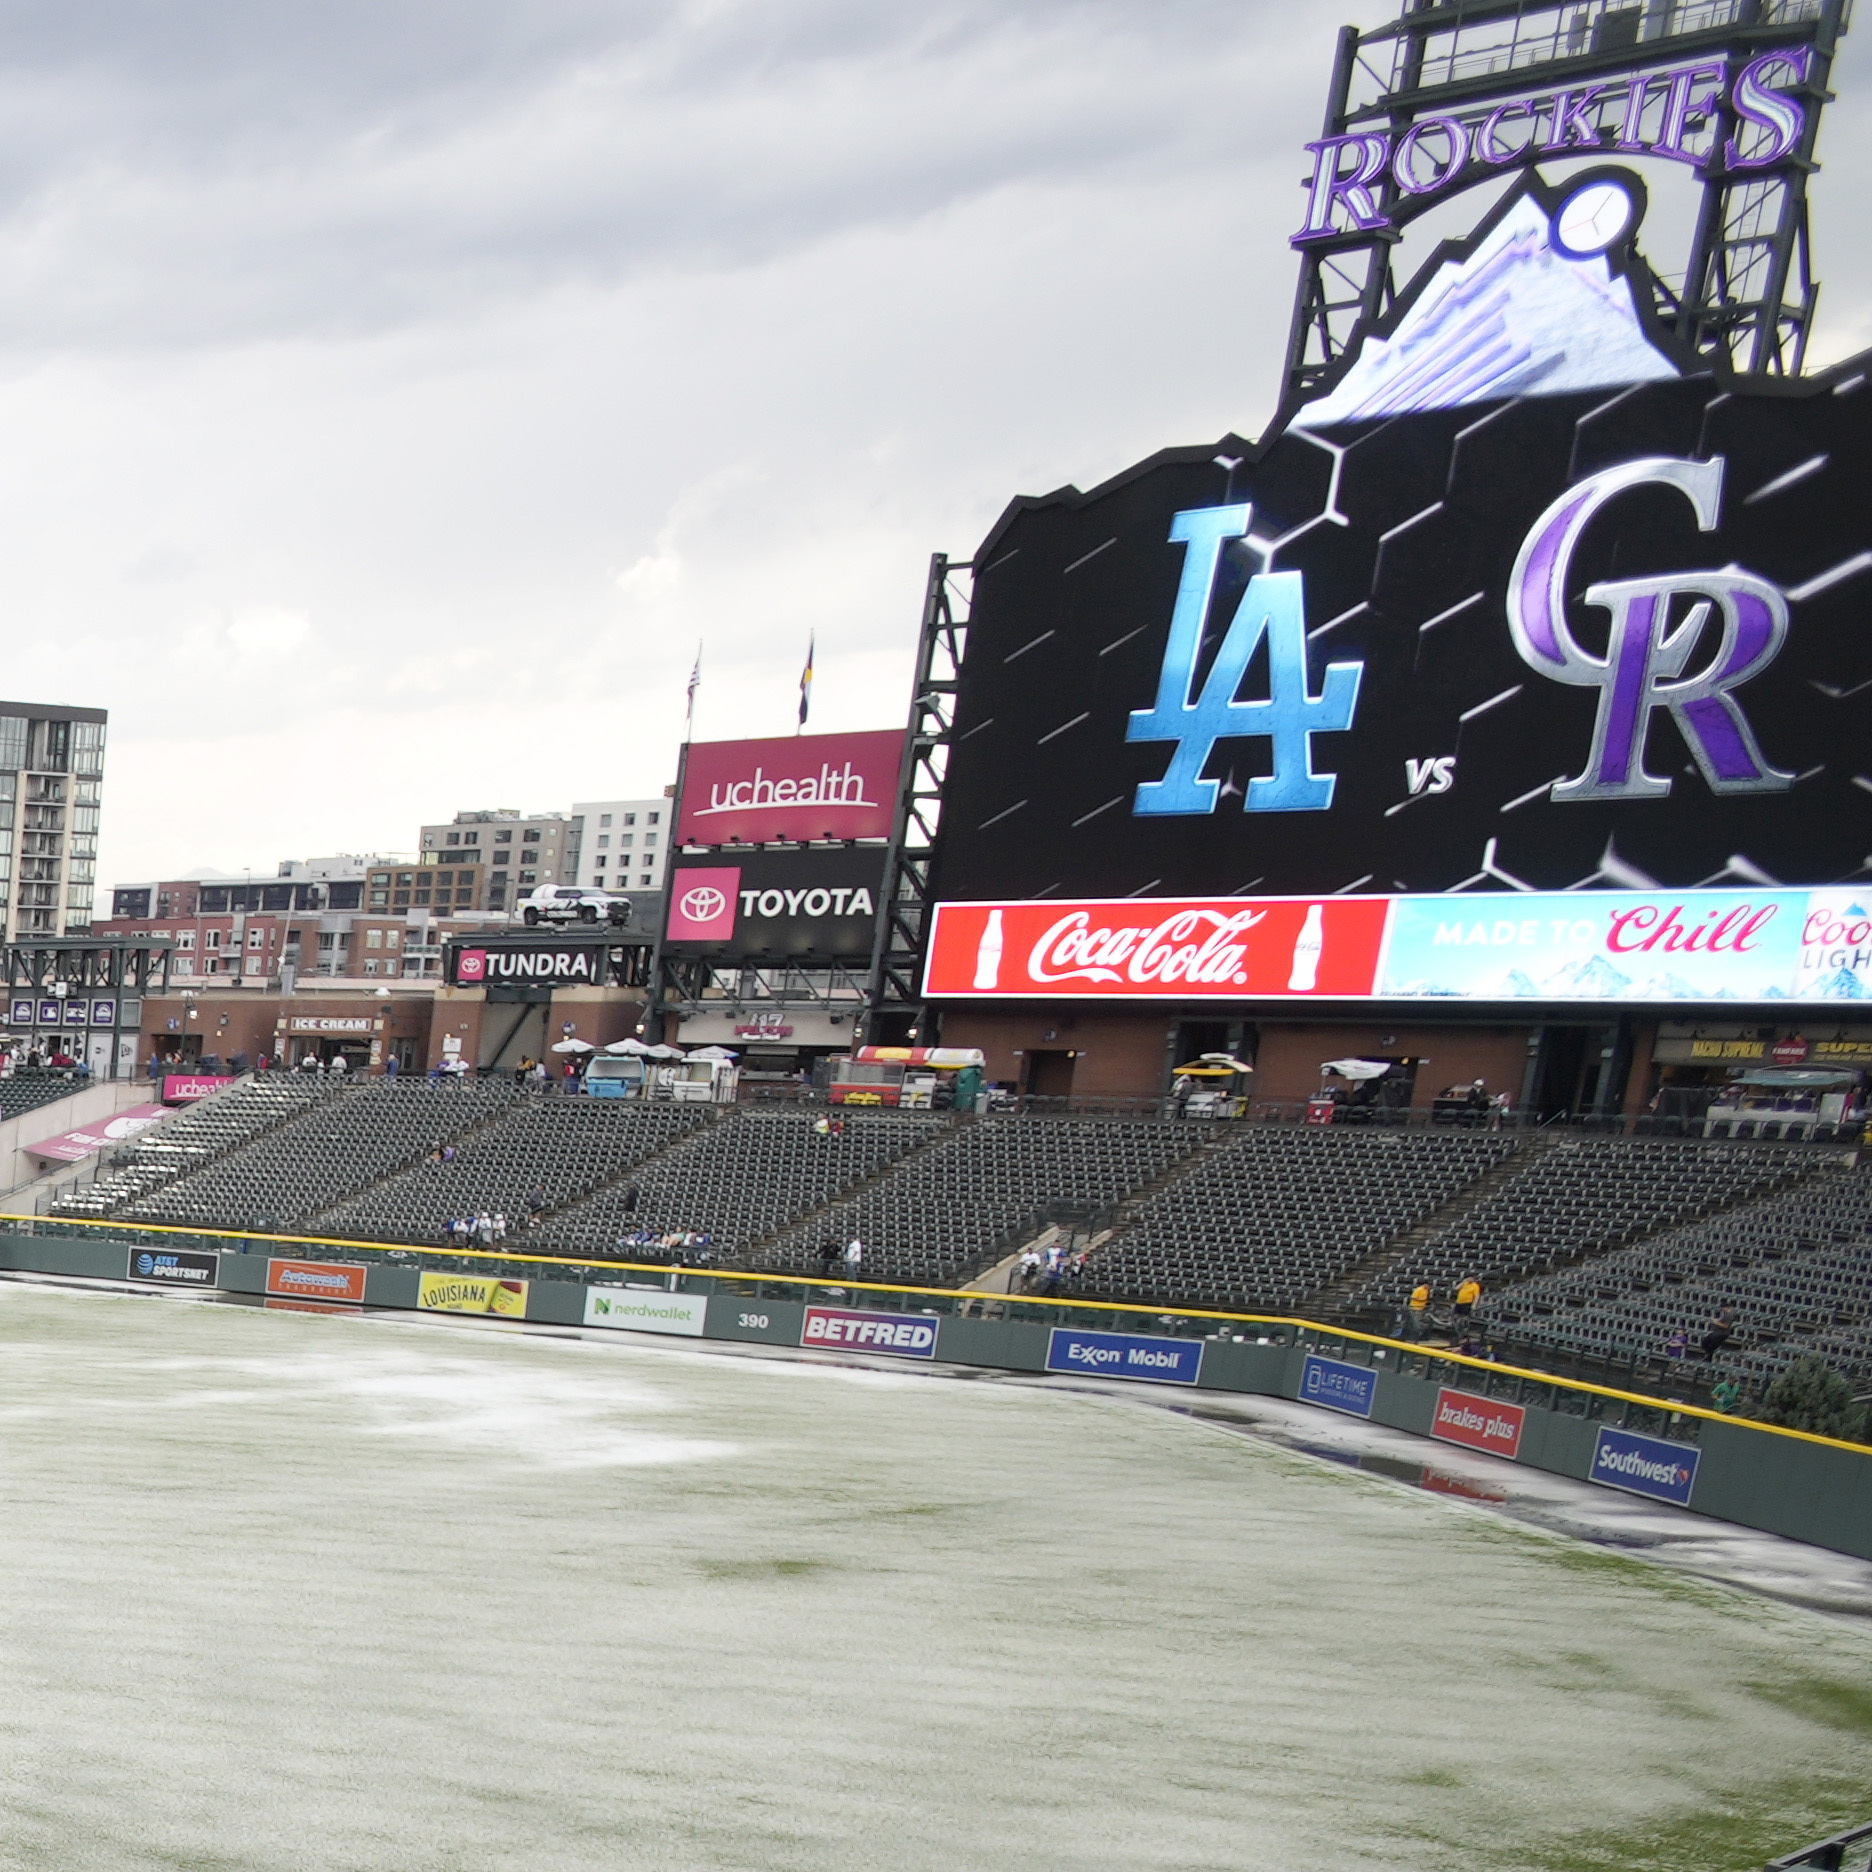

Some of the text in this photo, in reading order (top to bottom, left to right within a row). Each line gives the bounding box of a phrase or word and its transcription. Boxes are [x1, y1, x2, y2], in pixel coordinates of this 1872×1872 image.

[1289, 45, 1811, 242] ROCKIES
[1507, 456, 1796, 801] CR
[1125, 503, 1364, 816] LA
[710, 761, 864, 810] uchealth
[739, 887, 874, 917] TOYOTA
[1431, 903, 1779, 953] MADE TO Chill
[1802, 908, 1872, 946] Coo
[1027, 908, 1269, 984] Coca-Cola
[485, 952, 589, 976] TUNDRA
[294, 1017, 369, 1032] ICE CREAM
[152, 1264, 209, 1281] SPORTSNET
[154, 1255, 179, 1267] AT&T
[280, 1269, 347, 1288] Autowash
[423, 1284, 486, 1308] LOUISIANA
[615, 1304, 692, 1321] nerdwallet
[738, 1313, 769, 1329] 390
[806, 1316, 934, 1349] BETFRED
[1067, 1343, 1182, 1369] Exxon Mobil
[1320, 1371, 1368, 1397] LIFETIME
[1438, 1402, 1515, 1439] brakes plus
[1598, 1444, 1678, 1486] Southwest
